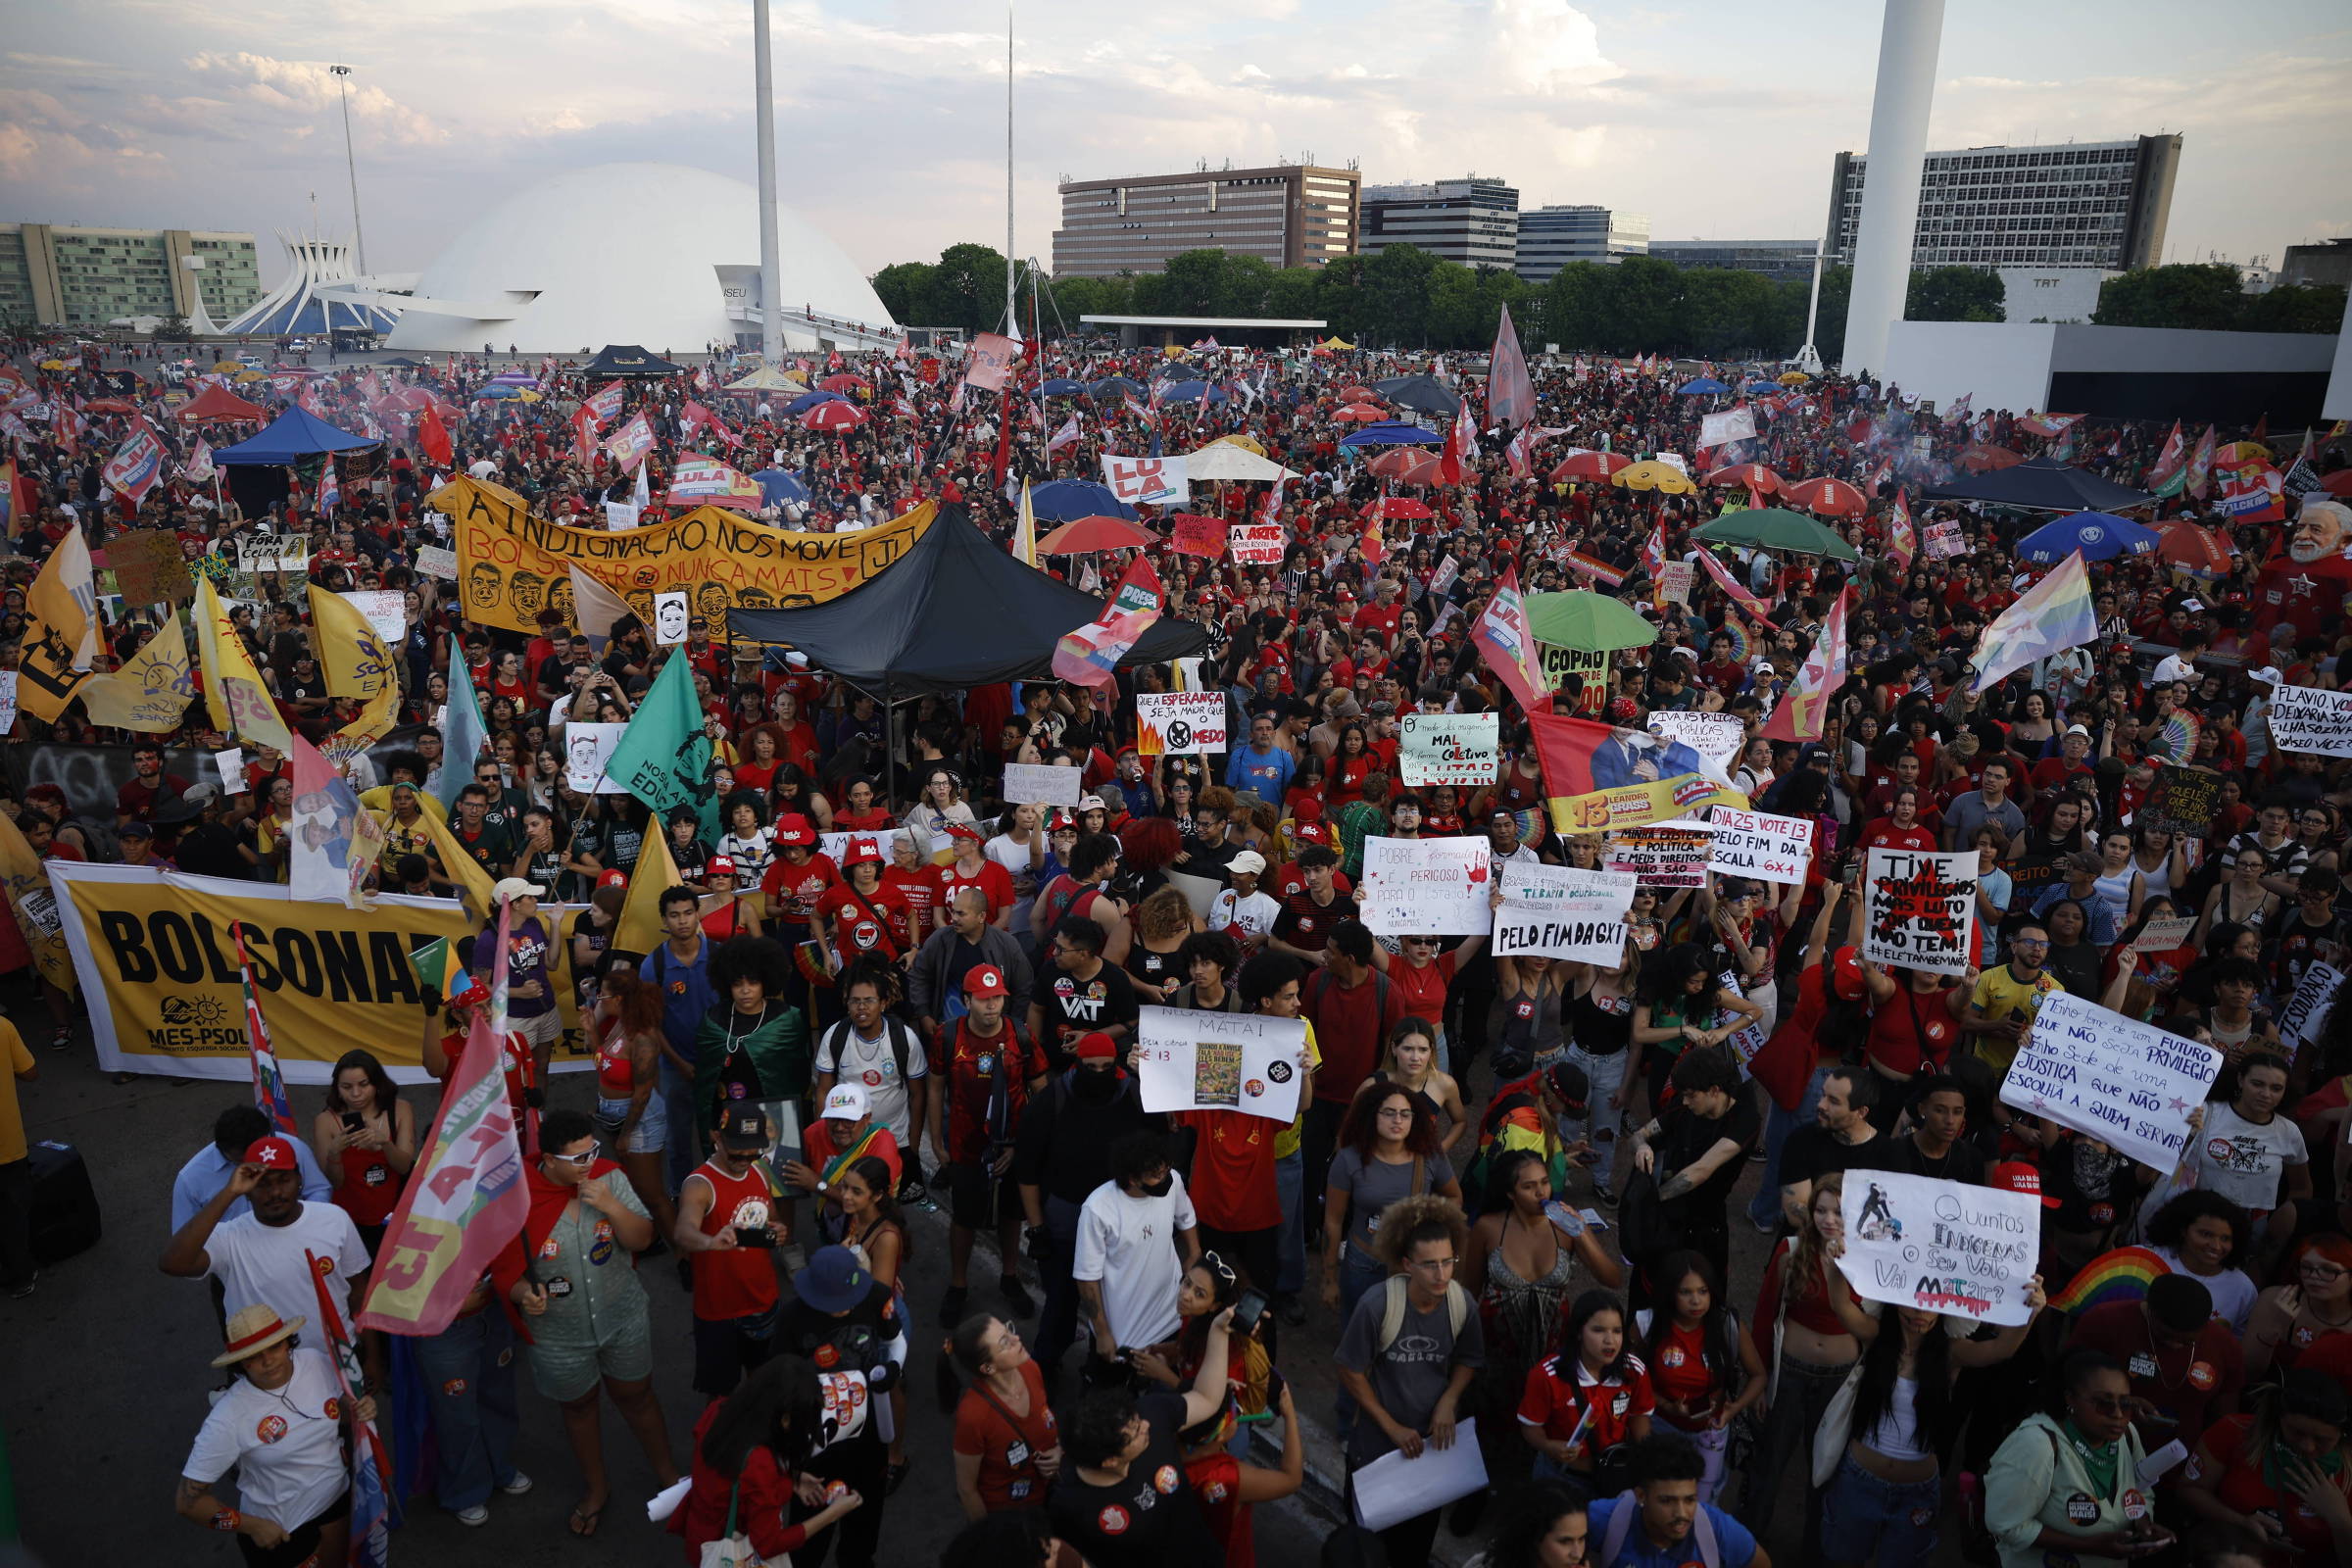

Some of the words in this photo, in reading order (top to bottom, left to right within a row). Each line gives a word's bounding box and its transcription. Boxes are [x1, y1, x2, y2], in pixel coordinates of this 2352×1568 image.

[2034, 278, 2060, 287] TRT
[673, 469, 726, 484] LULA
[733, 472, 753, 489] 13
[466, 491, 495, 525] A
[716, 518, 776, 558] NOS
[780, 535, 858, 561] MOVE
[1233, 528, 1243, 540] A
[1247, 526, 1281, 541] ARTE
[247, 534, 283, 549] FORA
[666, 557, 746, 586] NUNCA
[755, 565, 858, 593] MAIS!
[1138, 694, 1152, 707] QUE
[1153, 697, 1160, 706] A
[1161, 691, 1224, 707] ESPERANÇA
[1151, 708, 1177, 717] SEJA
[1181, 707, 1205, 716] MAIOR
[1208, 706, 1225, 715] QUE
[1649, 711, 1682, 723] VIVA
[1684, 711, 1698, 721] AS
[2273, 704, 2329, 723] DEIXARIA
[1403, 717, 1418, 733] O
[2306, 722, 2352, 735] SOZINH
[1192, 729, 1227, 744] MEDO
[1431, 734, 1461, 747] MAL
[2316, 737, 2340, 750] VICE
[2179, 768, 2208, 784] VOTE
[1609, 792, 1650, 804] LEANDRO
[1673, 781, 1716, 804] LULA
[1572, 793, 1611, 828] 13
[1611, 799, 1652, 814] GRASS
[1620, 829, 1655, 841] MINHA
[1758, 816, 1788, 834] VOTE
[1791, 823, 1807, 838] 13
[1713, 830, 1742, 847] PELO
[1746, 836, 1771, 852] FIM
[1781, 842, 1798, 857] DA
[1379, 846, 1415, 865] POBRE
[1616, 853, 1624, 862] E
[1627, 853, 1656, 863] MEUS
[1659, 854, 1703, 863] DIREITOS
[1711, 850, 1756, 868] SCALA
[1387, 869, 1395, 883] É
[1409, 868, 1459, 882] PERIGOSO
[1633, 862, 1658, 874] NÃO
[1664, 863, 1688, 874] SÃO
[1377, 888, 1403, 903] PARA
[1407, 887, 1416, 901] O
[1522, 888, 1564, 900] TERAPIA
[1872, 894, 1916, 912] MAS
[1924, 899, 1966, 914] LUTO
[1873, 910, 1910, 932] POR
[1917, 917, 1965, 932] QUEM
[2147, 918, 2191, 930] DITADURA
[1498, 925, 1539, 953] PELO
[1544, 925, 1574, 948] FIM
[1574, 921, 1592, 947] DA
[1593, 922, 1623, 946] 6X1
[2133, 935, 2163, 948] NUNCA
[2164, 934, 2182, 946] MAIS
[98, 908, 477, 1006] BOLSONA
[1060, 996, 1105, 1022] VAT
[2279, 965, 2333, 1039] TESOURAÇO
[1199, 1018, 1263, 1038] MATA!
[2034, 1015, 2062, 1032] QUE
[2068, 1025, 2097, 1044] NÃO
[2046, 996, 2080, 1019] Tenho
[2159, 1035, 2213, 1063] FUTURO
[147, 1027, 250, 1047] MES-PSOL
[1158, 1050, 1171, 1062] 13
[2016, 1050, 2078, 1087] JUSTIÇA
[2128, 1089, 2162, 1112] NÃO
[830, 1094, 857, 1108] LULA
[2007, 1070, 2064, 1102] ESCOLHA
[2069, 1094, 2081, 1107] A
[2088, 1100, 2132, 1132] QUEM
[2134, 1119, 2185, 1153] SERVIR
[1928, 1221, 2029, 1263] INDÍGENAS
[1386, 1350, 1446, 1363] OAKLEY
[2068, 1503, 2096, 1512] NUNCA
[2069, 1510, 2097, 1520] MAIS!
